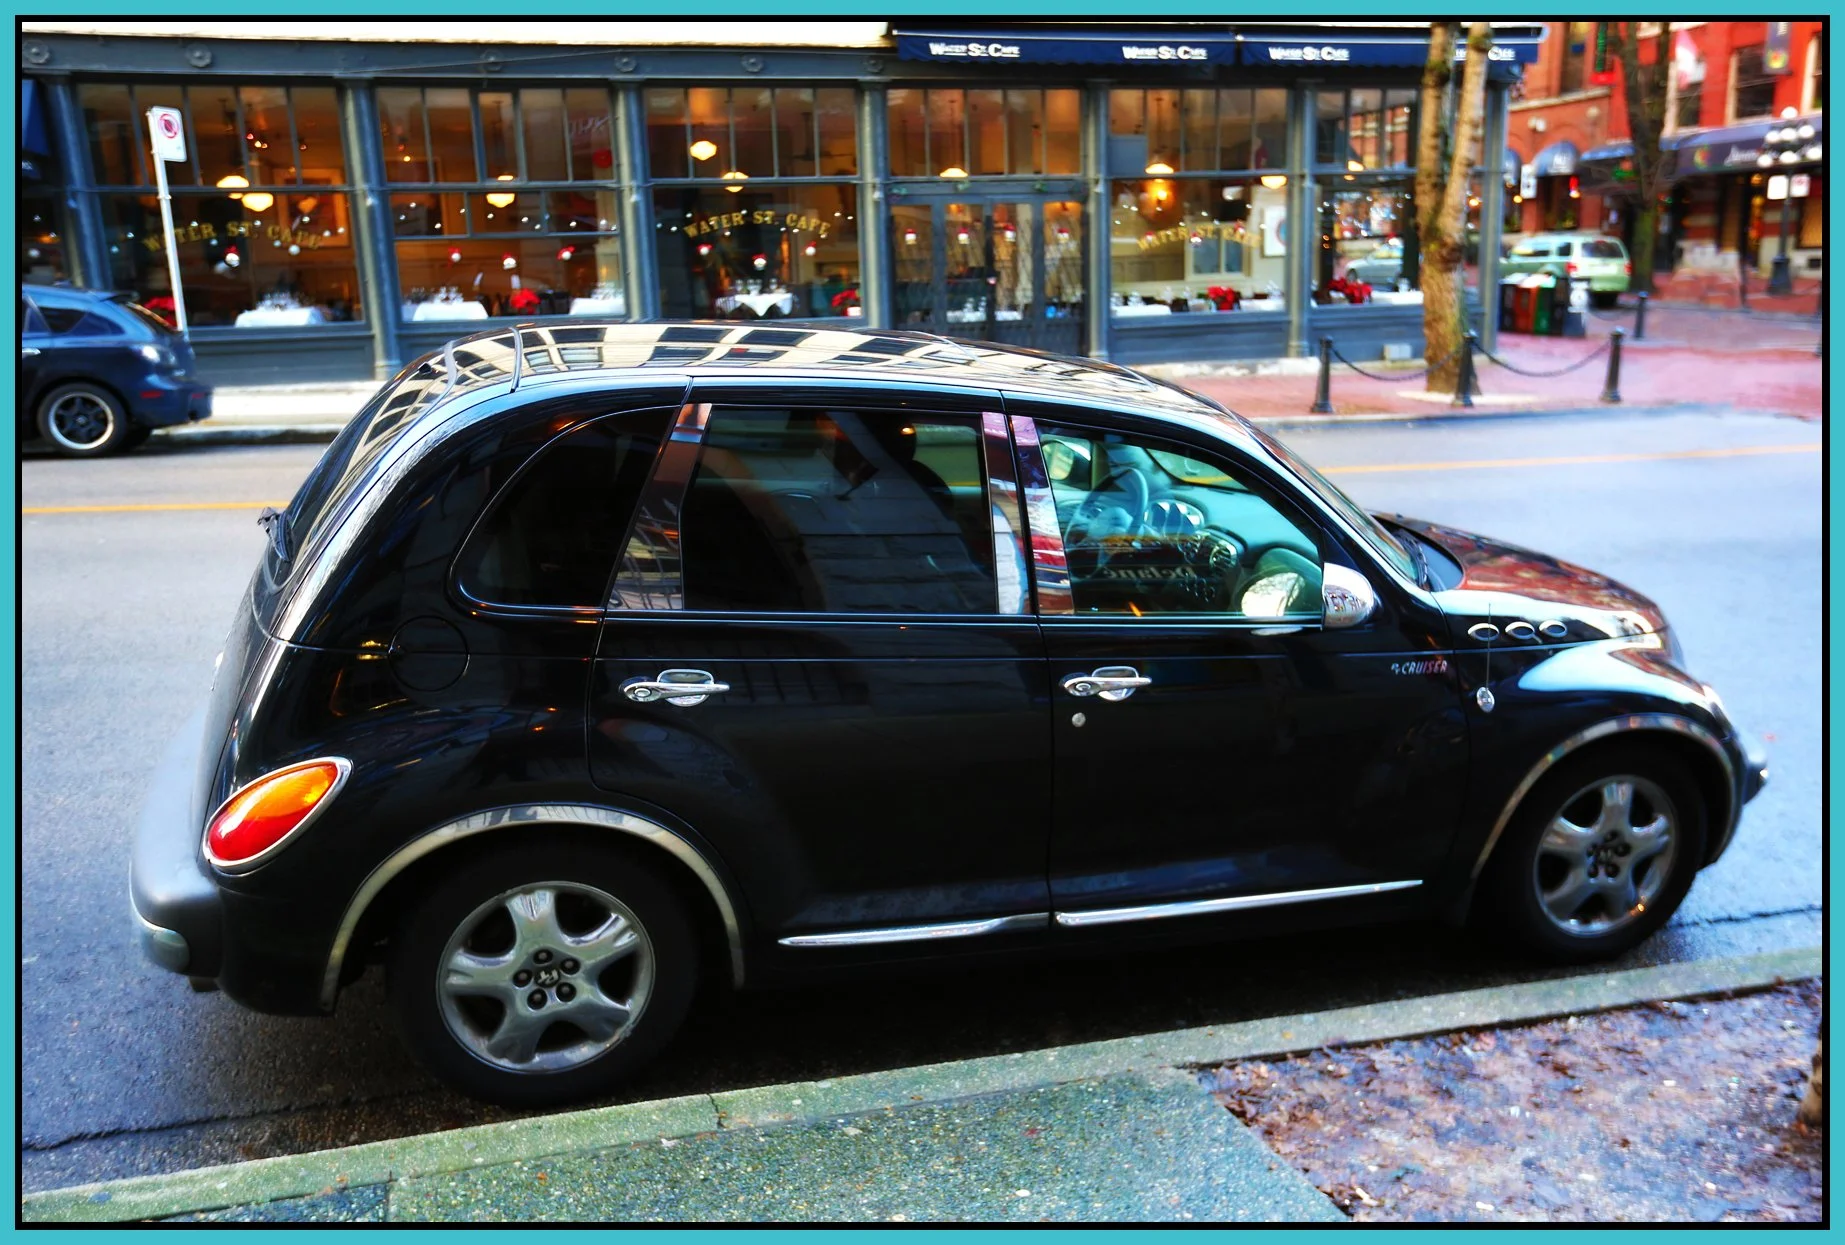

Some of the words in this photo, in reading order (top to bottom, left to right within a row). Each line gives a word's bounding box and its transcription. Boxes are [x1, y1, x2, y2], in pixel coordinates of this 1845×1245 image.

[143, 223, 217, 251] WTER
[683, 212, 745, 238] WATER
[786, 213, 831, 236] CAFE
[1401, 660, 1448, 675] CRUISER
